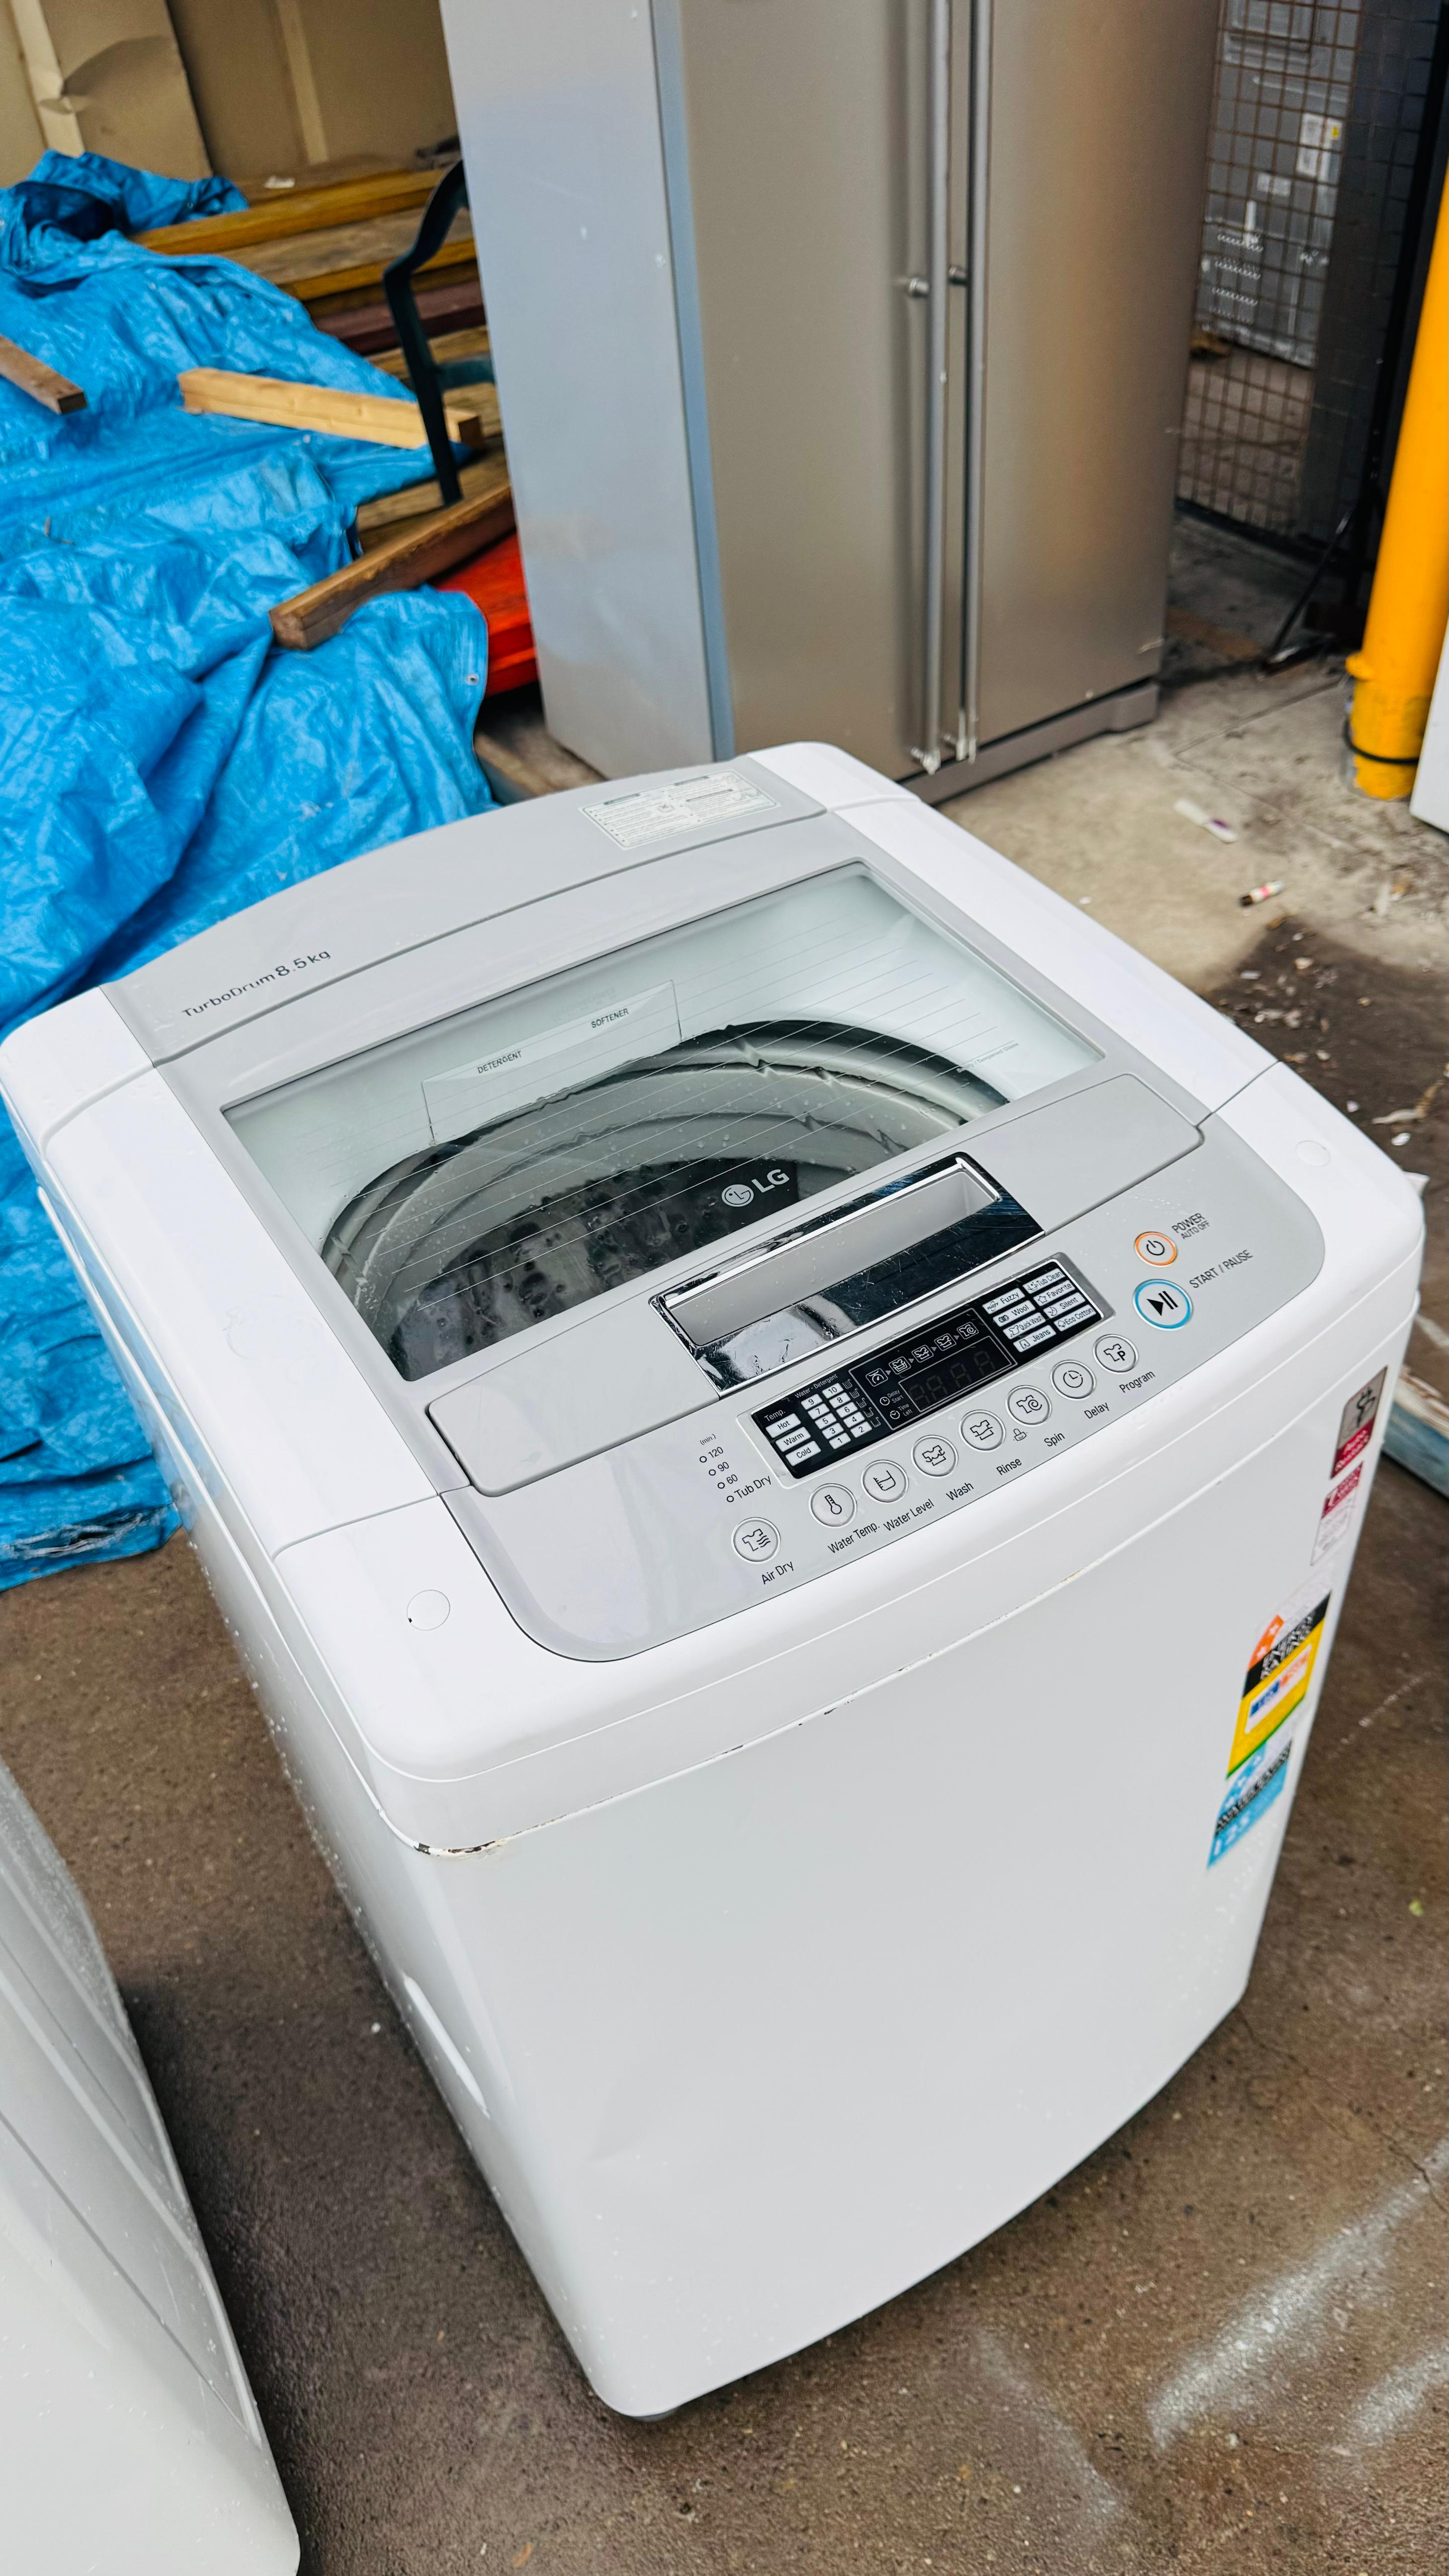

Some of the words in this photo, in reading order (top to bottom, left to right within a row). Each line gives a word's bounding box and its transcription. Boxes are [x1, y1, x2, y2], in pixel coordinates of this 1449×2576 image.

[182, 974, 276, 1017] TurboDrum
[275, 958, 307, 977] 8.5
[307, 951, 331, 963] kg
[591, 1008, 629, 1028] SOFTENER
[477, 1050, 523, 1074] DETERGENT
[751, 1169, 790, 1193] LG
[1171, 1213, 1205, 1233] POWER
[1180, 1227, 1199, 1240] AUTO
[1197, 1221, 1210, 1232] OFF
[1047, 1271, 1063, 1281] Clean
[1189, 1268, 1219, 1289] START
[1218, 1264, 1225, 1273] /
[1223, 1250, 1253, 1269] PAUSE
[1000, 1292, 1020, 1304] Fuzzy
[1046, 1283, 1072, 1298] Favorite
[1011, 1305, 1029, 1316] Wool
[1060, 1297, 1079, 1310] Silent
[1075, 1307, 1093, 1320] Cotton
[1019, 1319, 1032, 1330] Quick
[1031, 1315, 1044, 1324] Wash
[1032, 1329, 1051, 1342] Jeans
[1119, 1371, 1155, 1393] Program
[795, 1388, 811, 1399] Water
[764, 1410, 786, 1422] Temp.
[1084, 1402, 1110, 1419] Delay
[777, 1420, 790, 1430] Hot
[700, 1433, 716, 1445] (min.)
[783, 1433, 804, 1446] Warm
[1044, 1432, 1066, 1447] Spin
[708, 1446, 723, 1459] 120
[796, 1447, 811, 1459] Cold
[717, 1461, 730, 1472] 90
[996, 1457, 1022, 1476] Rinse
[726, 1474, 738, 1485] 60
[734, 1485, 754, 1499] Tub
[753, 1476, 772, 1489] Dry
[945, 1482, 974, 1501] Wash
[883, 1510, 911, 1532] Water
[910, 1498, 935, 1517] Level
[827, 1534, 855, 1554] Water
[853, 1522, 880, 1540] Temp.
[762, 1571, 775, 1585] Air
[775, 1561, 794, 1576] Dry
